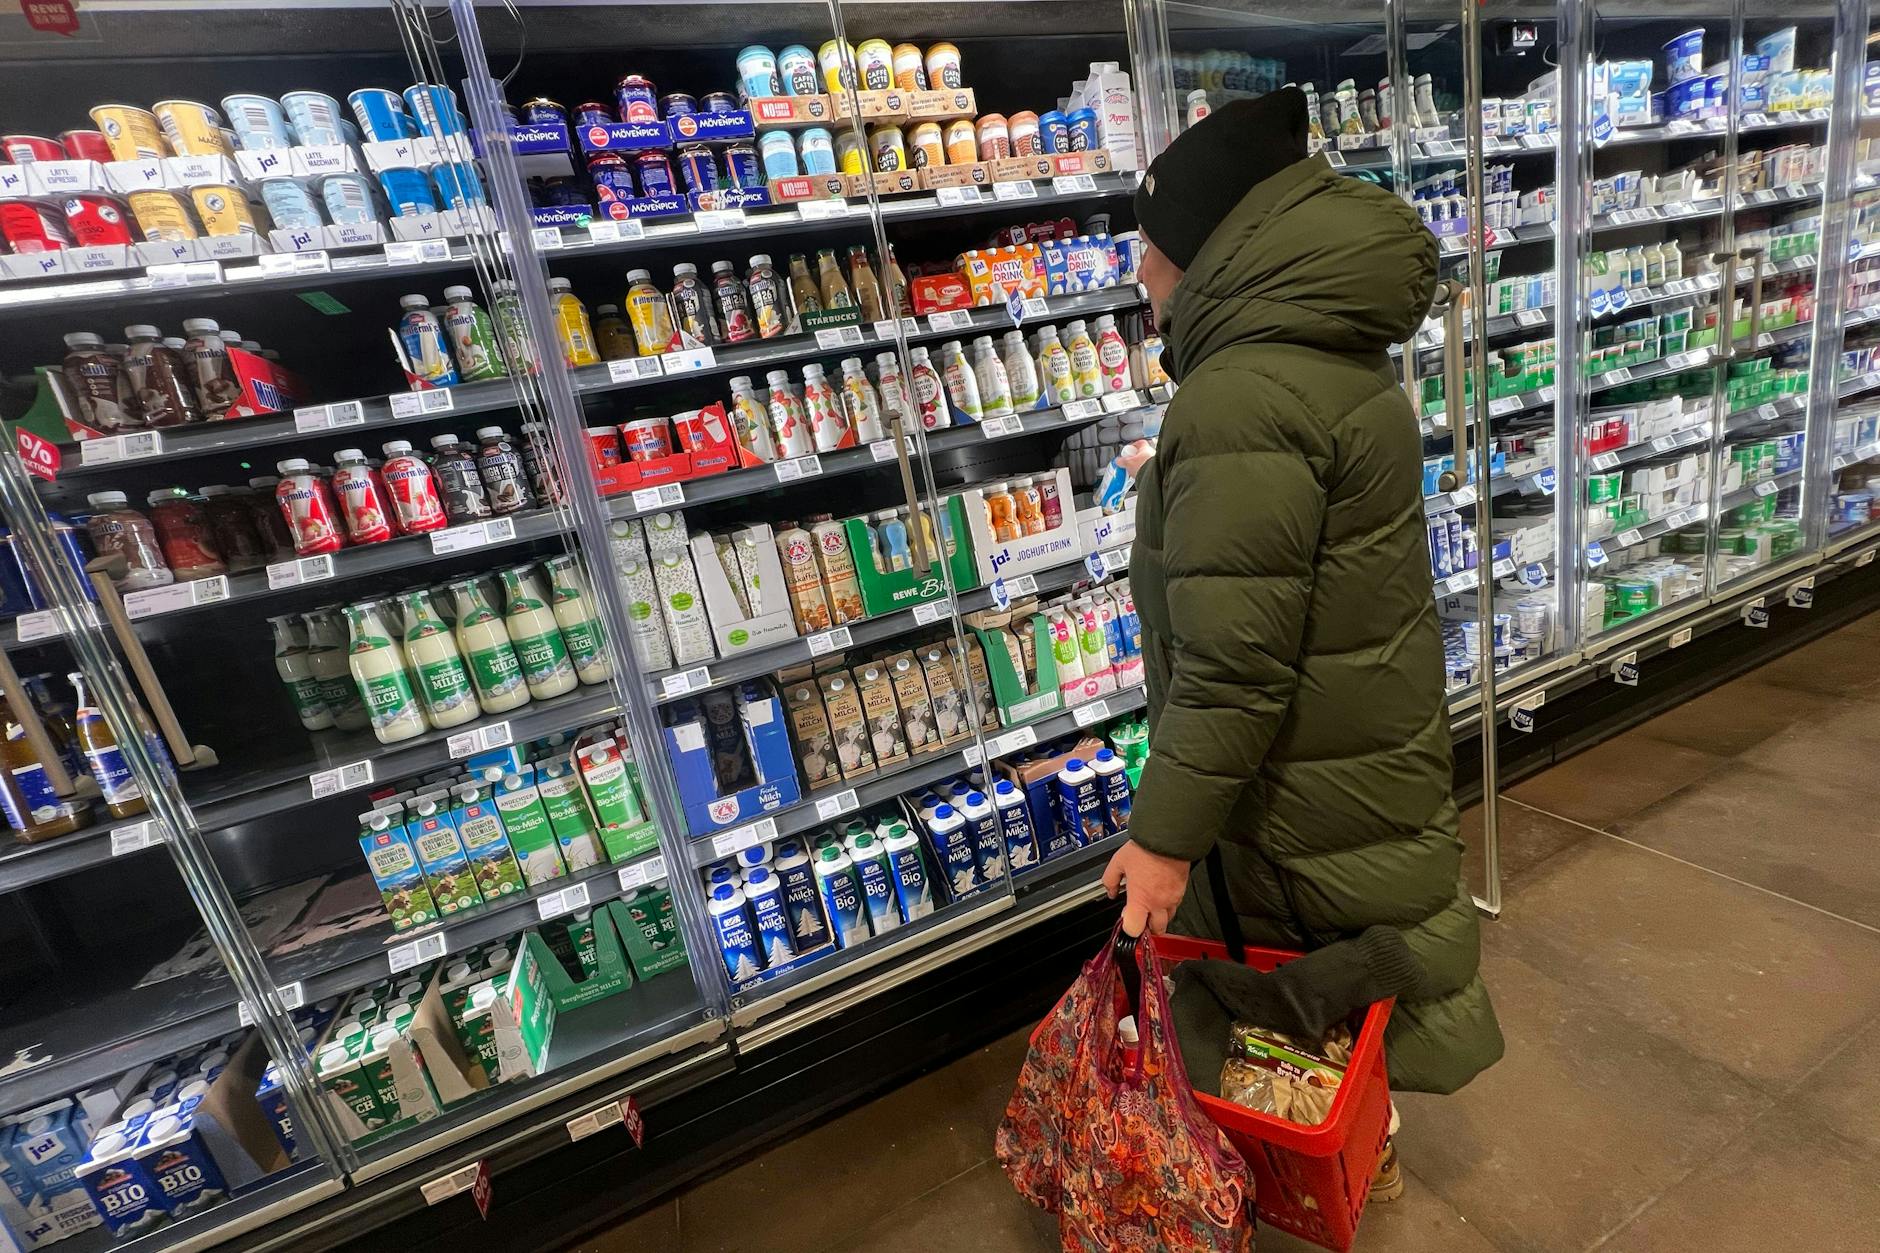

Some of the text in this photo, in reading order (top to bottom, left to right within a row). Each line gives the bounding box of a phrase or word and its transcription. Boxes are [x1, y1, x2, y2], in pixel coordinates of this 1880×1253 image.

[31, 3, 67, 14] REWE
[795, 81, 815, 91] LATTE
[869, 76, 888, 86] LATTE
[762, 104, 776, 117] NO
[700, 113, 747, 128] MÖVENPICK
[1108, 115, 1130, 124] Ayran
[612, 125, 661, 139] MÖVENPICK
[305, 152, 325, 162] LATTE
[397, 147, 409, 158] ja!
[257, 154, 280, 174] ja!
[308, 157, 341, 169] MACCHIATO
[880, 160, 898, 170] LATTE
[2, 172, 20, 188] ja!
[144, 167, 159, 180] ja!
[782, 184, 795, 196] NO
[632, 199, 679, 214] MÖVENPICK
[535, 208, 586, 223] MÖVENPICK
[340, 229, 357, 238] LATTE
[421, 223, 433, 233] ja!
[291, 232, 312, 248] ja!
[342, 234, 374, 243] MACCHIATO
[172, 246, 188, 258] ja!
[1050, 250, 1062, 262] ja!
[1068, 250, 1096, 264] AKTIV
[41, 257, 58, 271] ja!
[972, 261, 986, 273] ja!
[993, 259, 1023, 272] AKTIV
[1069, 261, 1097, 274] DRINK
[994, 269, 1024, 283] DRINK
[763, 291, 773, 301] 26
[684, 301, 694, 311] 26
[806, 313, 858, 326] STARBUCKS
[1103, 348, 1123, 357] Butter
[1105, 354, 1122, 363] Milch
[20, 433, 52, 465] %
[22, 457, 53, 477] AKTION
[502, 463, 516, 478] 26
[1044, 485, 1057, 498] ja!
[1094, 522, 1112, 544] ja!
[989, 537, 1072, 572] ja! JOGHURT DRINK
[893, 588, 919, 601] REWE
[524, 648, 556, 664] MILCH
[429, 667, 463, 681] Bergbauern
[431, 672, 466, 689] MILCH
[902, 683, 917, 692] VOLL
[932, 676, 956, 688] MILCH
[870, 694, 885, 703] VOLL
[900, 687, 923, 698] MILCH
[836, 704, 852, 713] VOLL
[867, 698, 891, 708] MILCH
[833, 707, 858, 719] MILCH
[799, 719, 824, 730] MILCH
[801, 716, 816, 724] VOLL
[760, 784, 779, 796] Frische
[1107, 789, 1130, 804] Kakao
[596, 788, 633, 806] Bio-Milch
[758, 790, 782, 804] Milch
[550, 802, 587, 818] Bio-Milch
[1078, 799, 1101, 814] Kakao
[507, 815, 545, 832] Bio-Milch
[468, 824, 497, 838] VOLLMILCH
[1006, 824, 1030, 837] Milch
[978, 837, 1001, 851] Milc
[948, 848, 972, 864] Milch
[901, 872, 921, 886] Bio
[788, 888, 815, 902] Milch
[866, 882, 887, 898] Bio
[835, 896, 856, 910] Bio
[761, 910, 779, 922] Frische
[758, 915, 786, 932] Milch
[727, 928, 745, 939] Frische
[723, 932, 753, 949] Milch
[642, 954, 681, 972] Bergbauern
[775, 964, 795, 977] Frische
[561, 979, 622, 1005] Bergbauern MILCH
[1300, 1050, 1321, 1062] Braten
[1293, 1066, 1301, 1074] zu
[29, 1138, 57, 1160] ja!
[158, 1165, 203, 1191] BIO
[100, 1183, 146, 1210] BIO
[54, 1202, 93, 1221] FRISCHE
[25, 1220, 53, 1241] ja!
